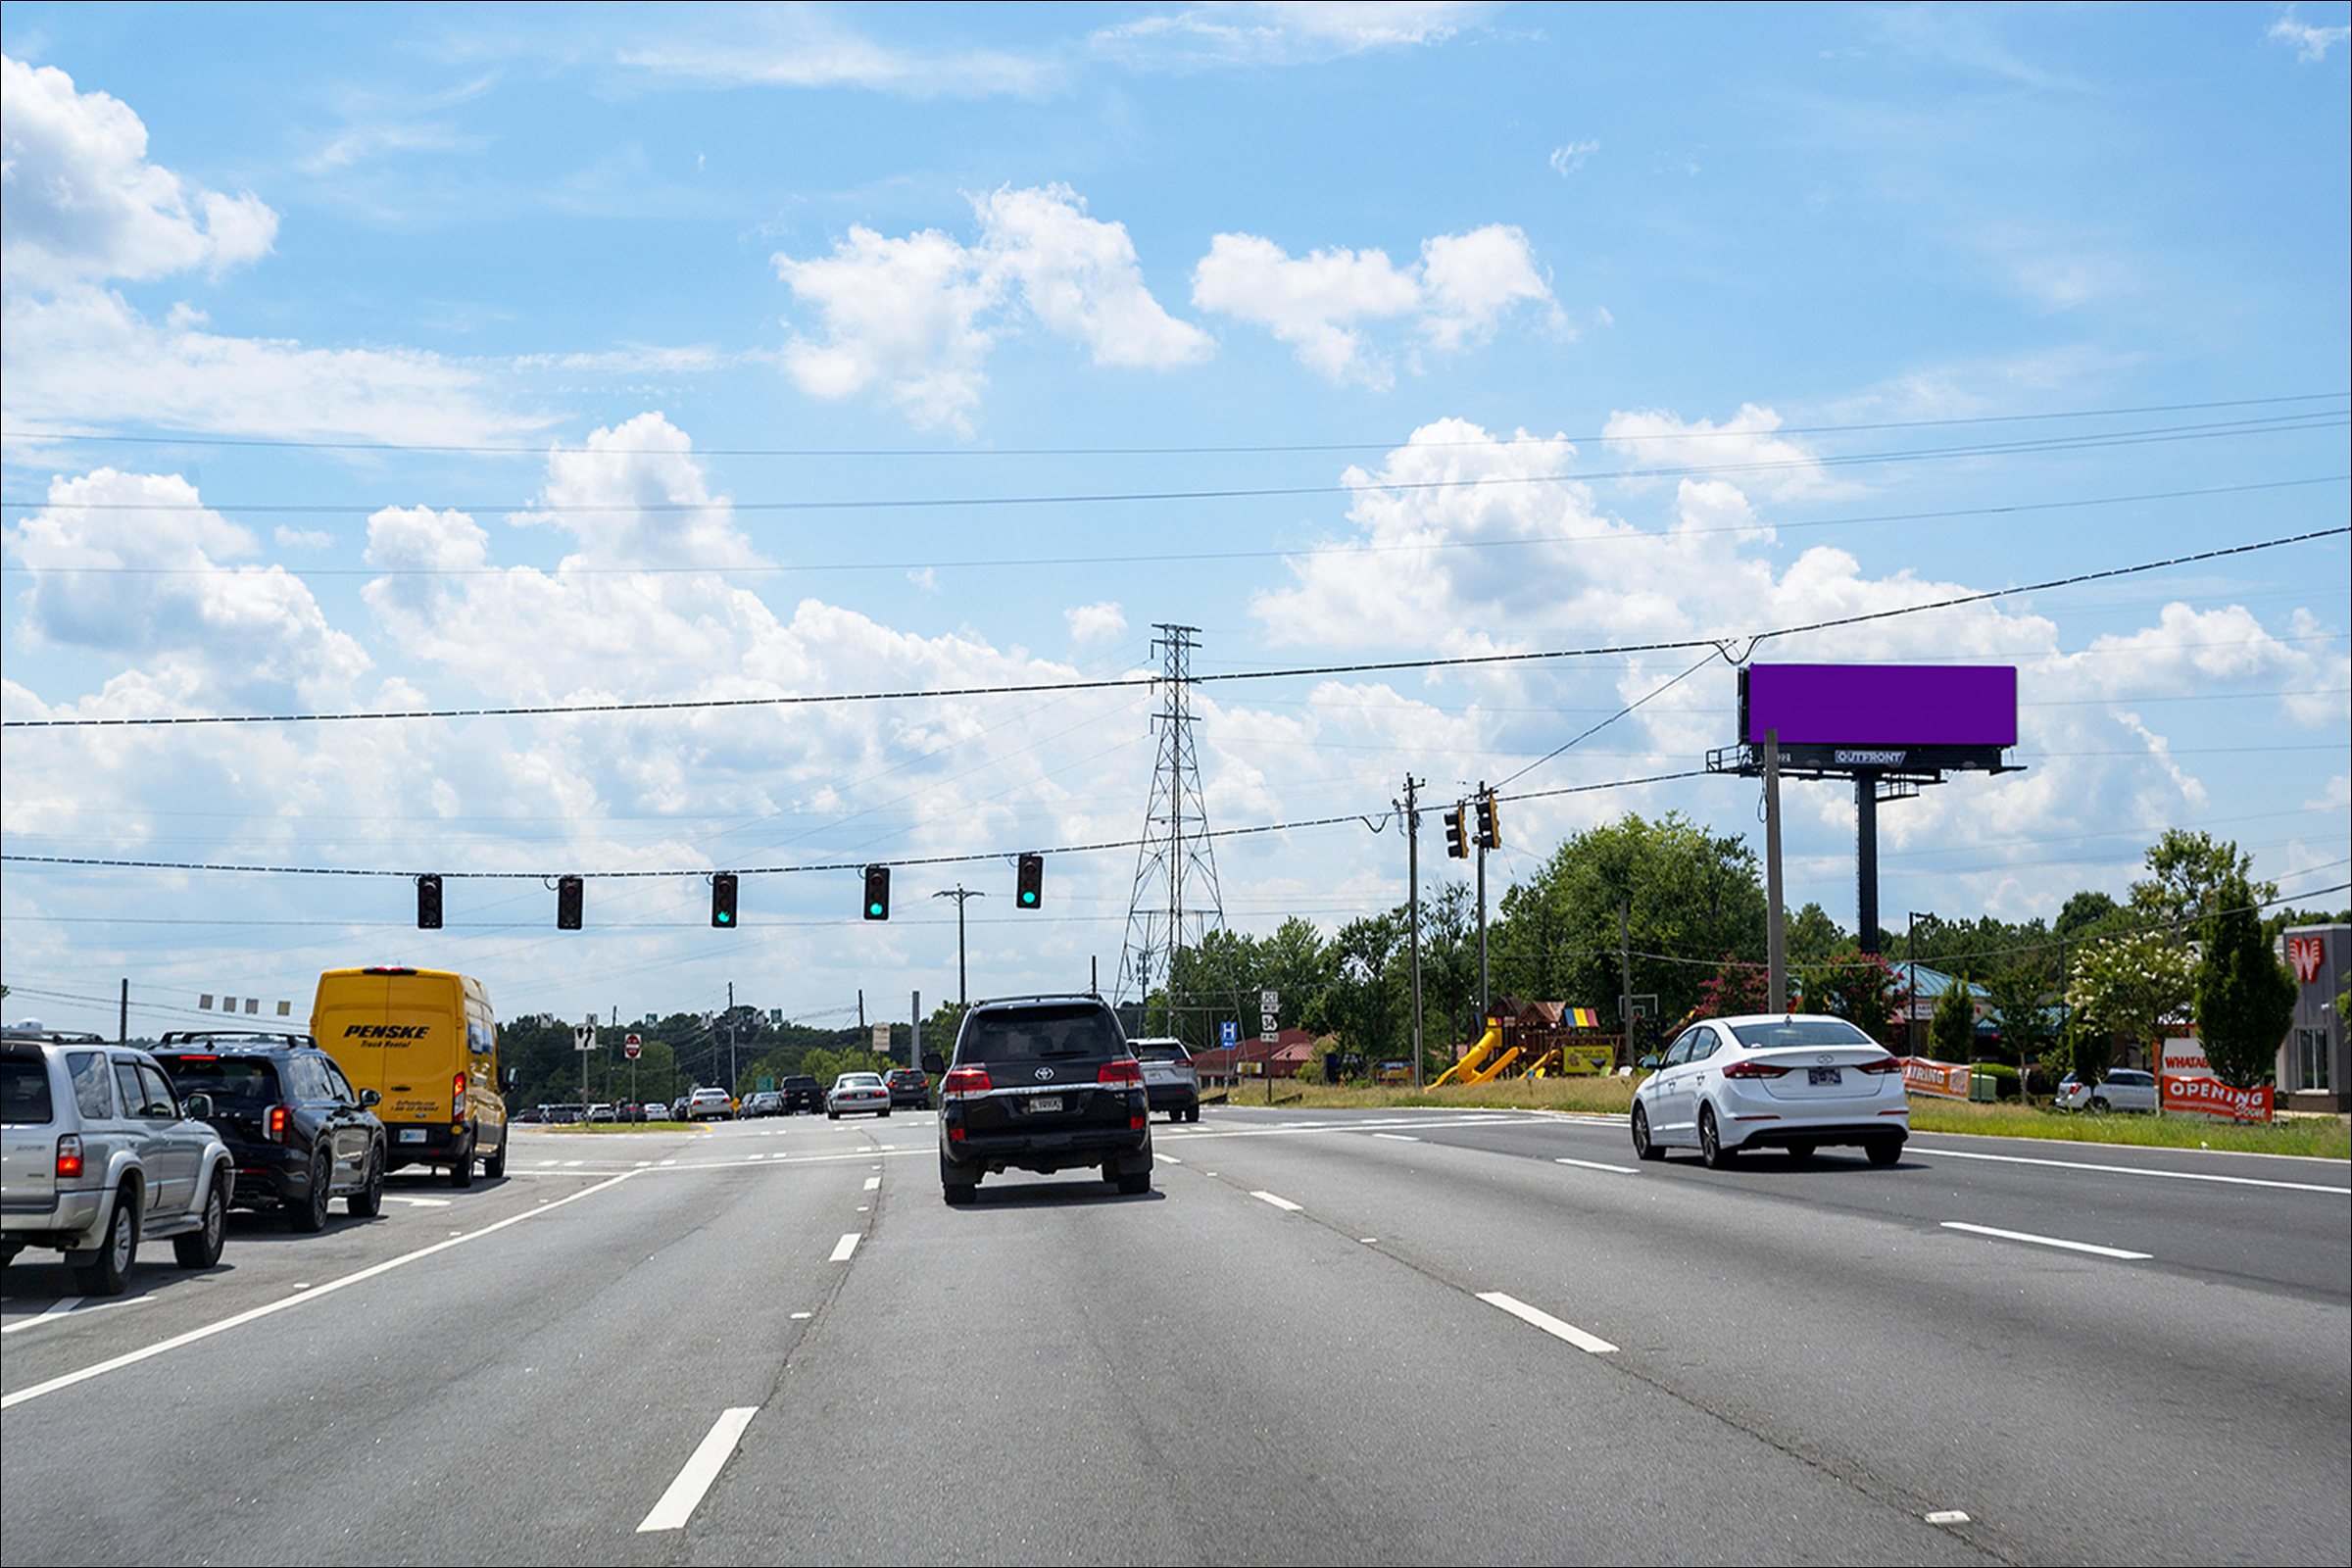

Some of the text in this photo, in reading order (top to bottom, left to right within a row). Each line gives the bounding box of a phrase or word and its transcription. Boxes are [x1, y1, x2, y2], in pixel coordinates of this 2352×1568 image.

[1838, 752, 1903, 763] OUTFRONT
[1264, 1017, 1274, 1029] 34
[343, 1025, 430, 1039] PENSKE
[1223, 1023, 1235, 1039] H
[2171, 1082, 2264, 1105] OPENING
[2234, 1102, 2266, 1117] Soon
